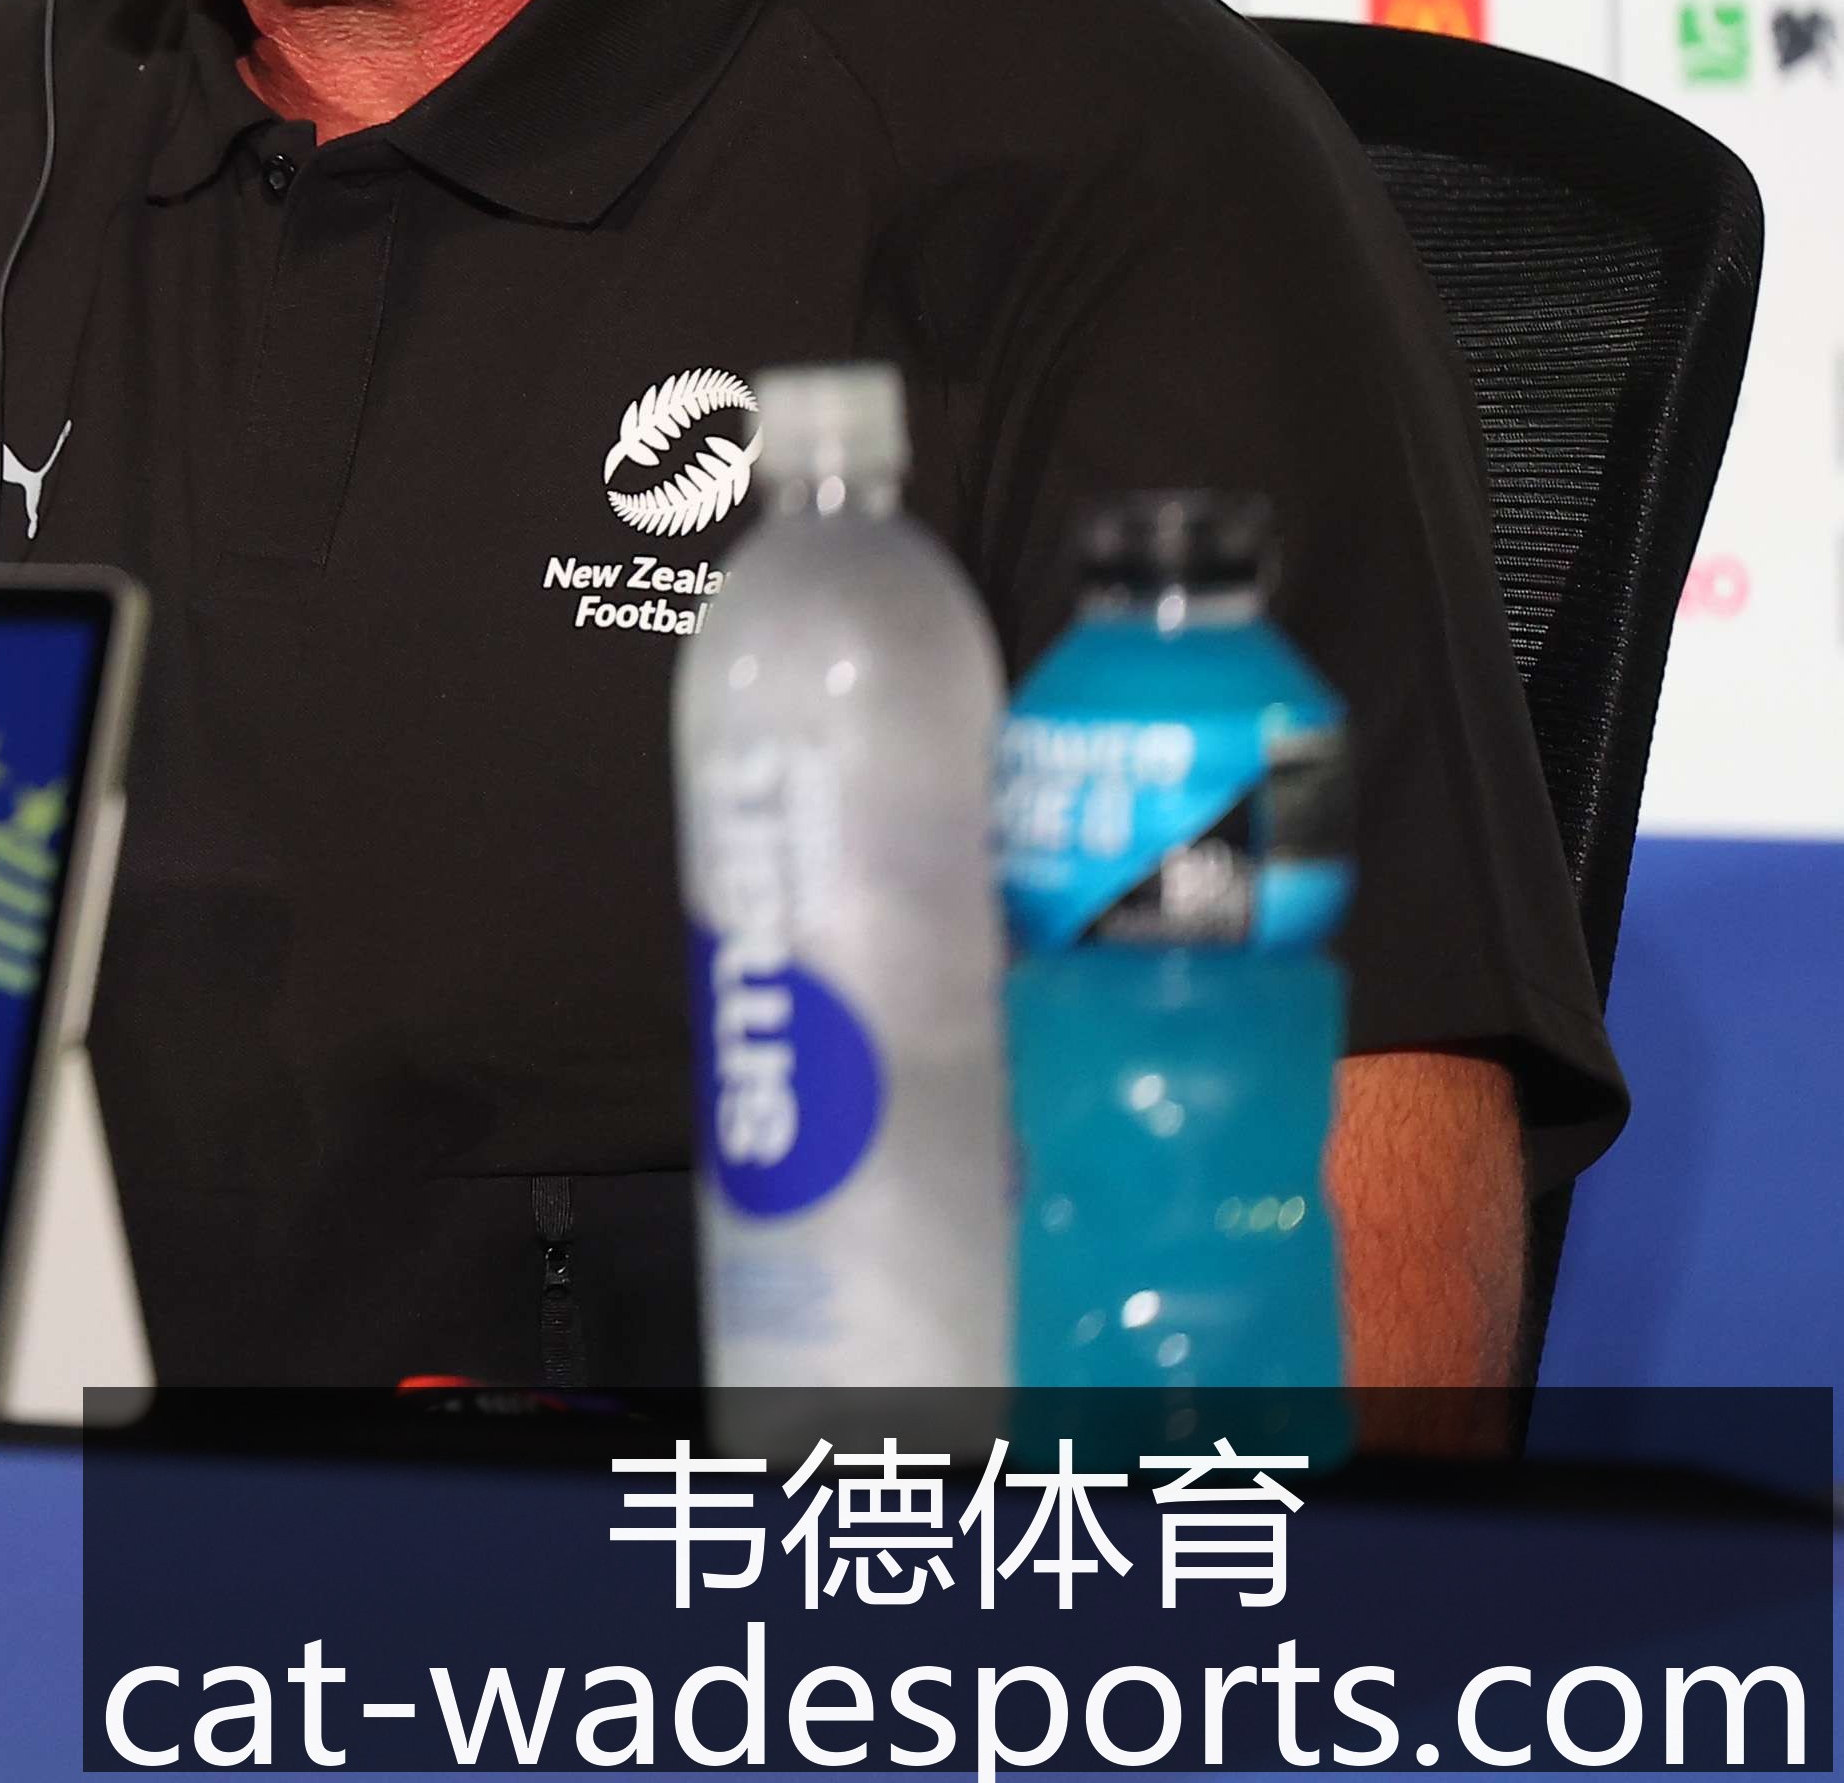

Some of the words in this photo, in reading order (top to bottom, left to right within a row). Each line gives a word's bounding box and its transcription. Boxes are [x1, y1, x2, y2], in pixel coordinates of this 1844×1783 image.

[543, 557, 623, 590] New
[627, 556, 725, 596] Zeala
[575, 595, 711, 635] Footbal
